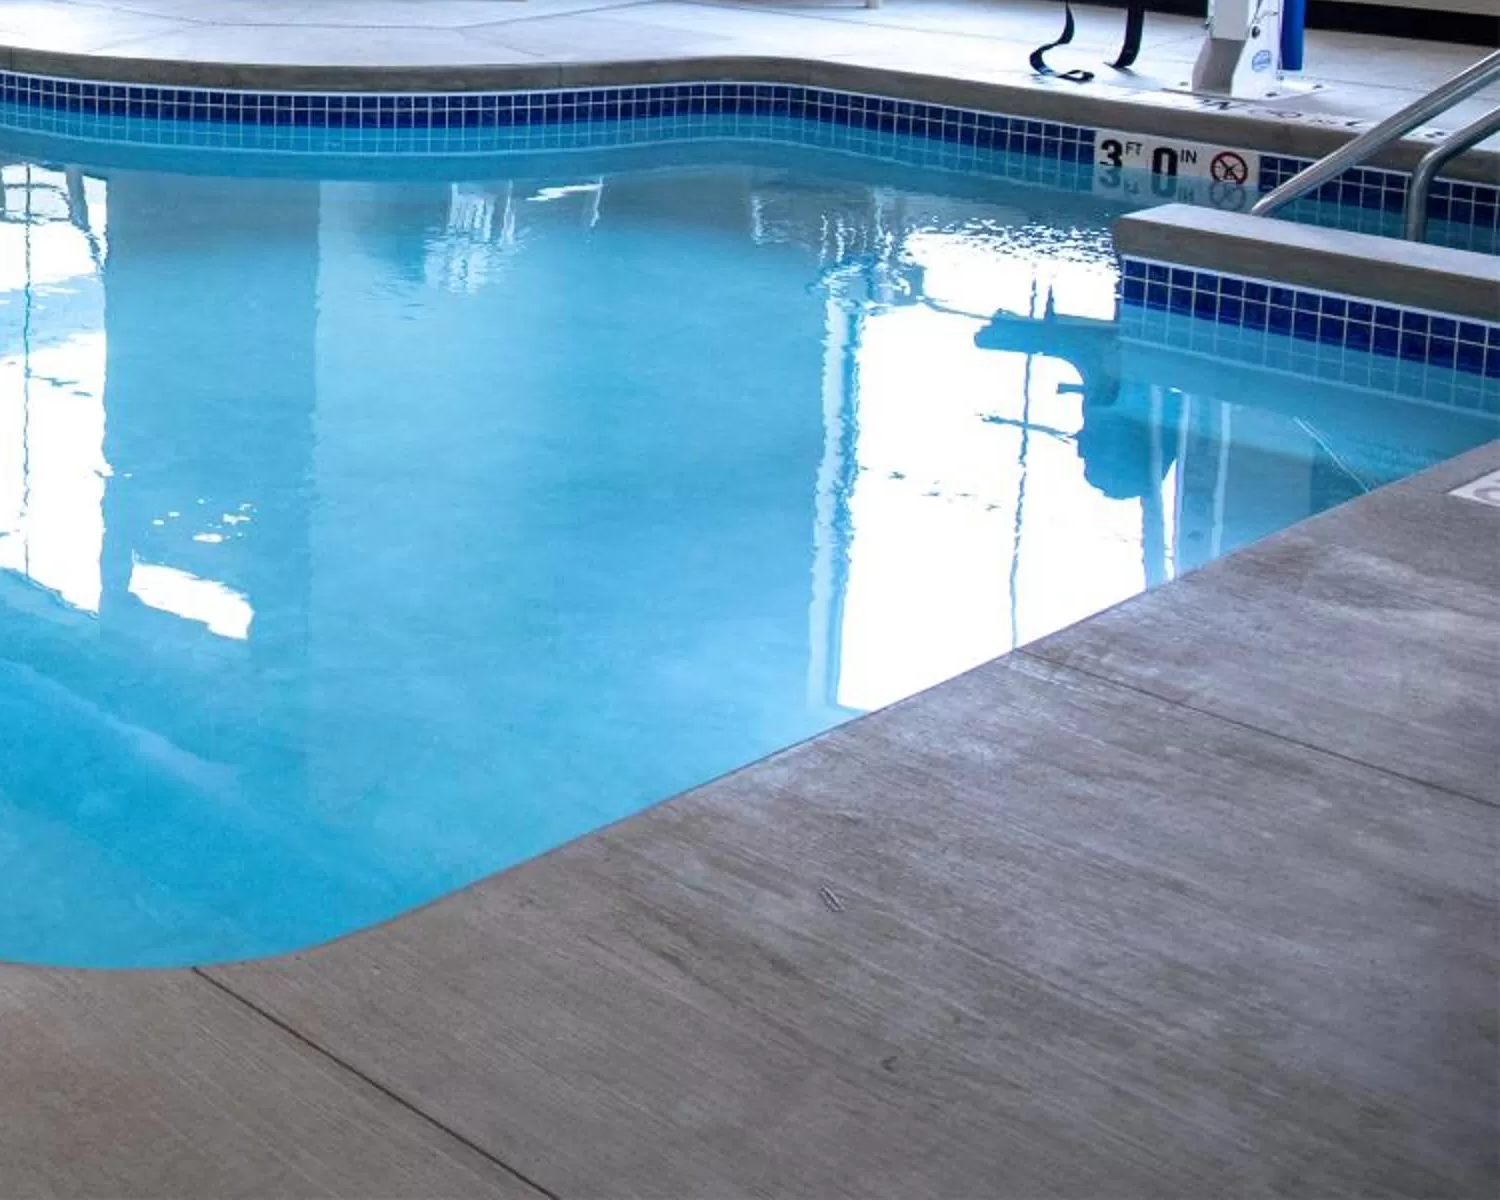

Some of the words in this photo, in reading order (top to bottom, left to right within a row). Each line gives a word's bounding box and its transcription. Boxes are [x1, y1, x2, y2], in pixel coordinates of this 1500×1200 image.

[1100, 139, 1123, 168] 3
[1125, 141, 1143, 156] FT
[1152, 146, 1178, 177] 0
[1180, 148, 1197, 164] IN
